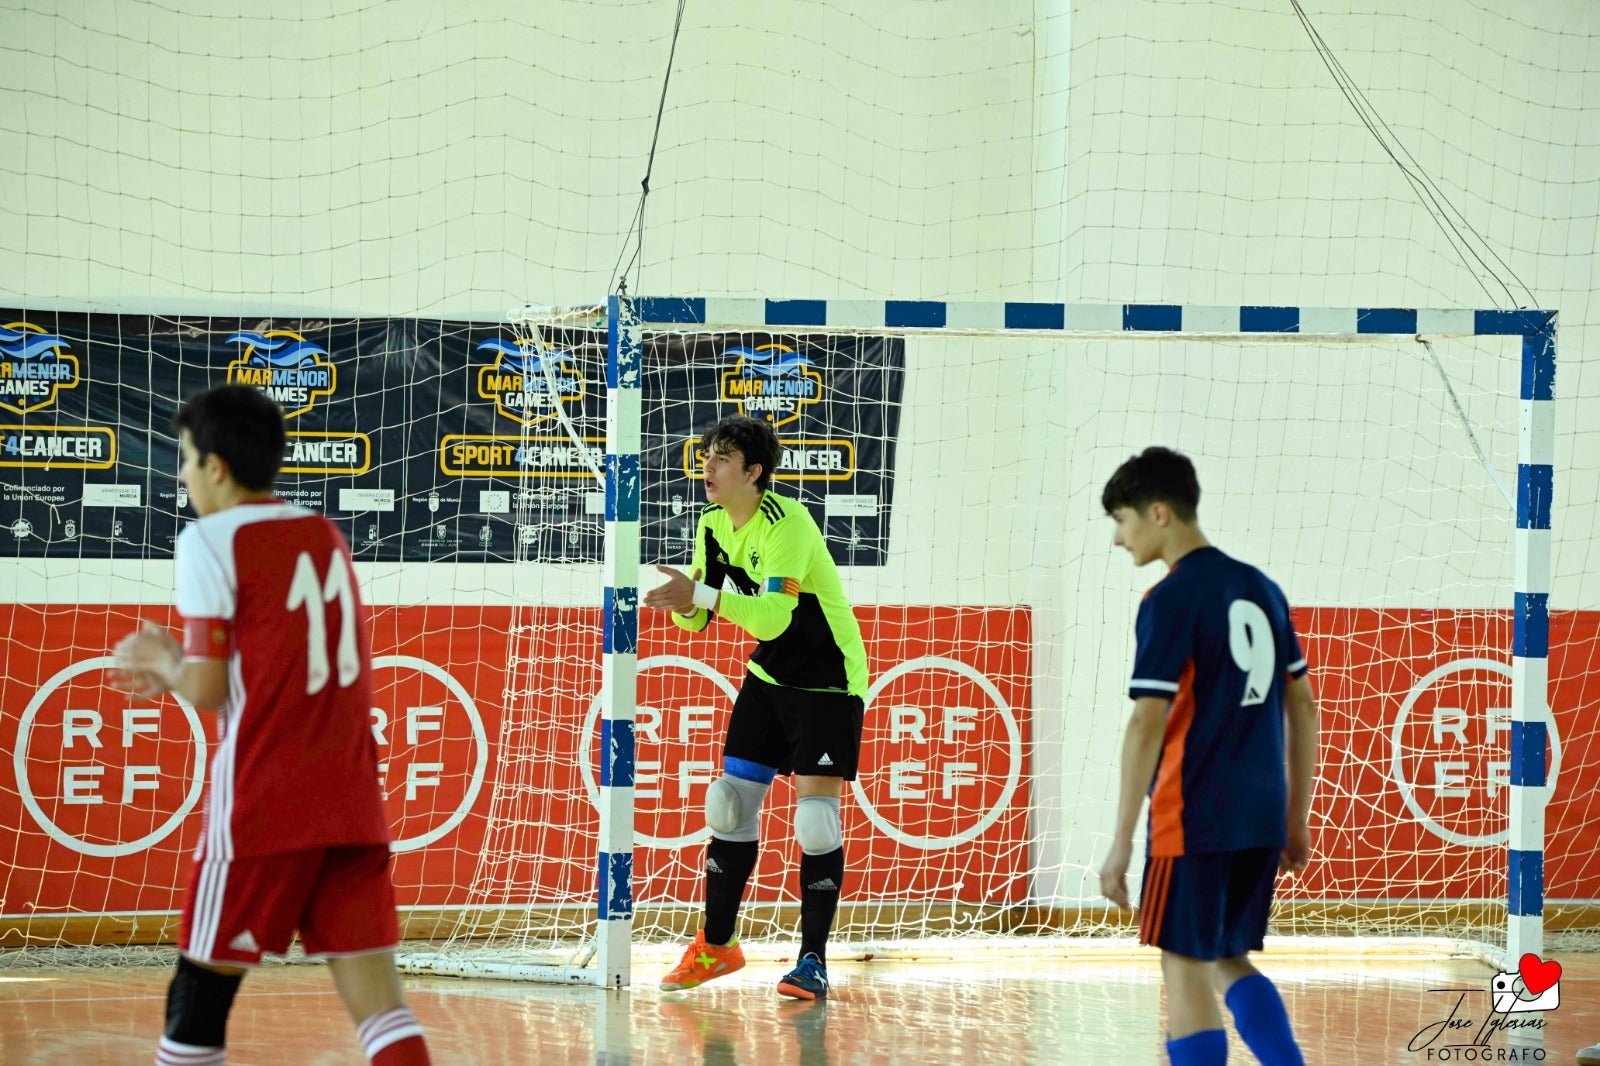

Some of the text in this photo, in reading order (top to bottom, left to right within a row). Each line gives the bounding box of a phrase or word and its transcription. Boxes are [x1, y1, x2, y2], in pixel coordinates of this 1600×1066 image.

[0, 362, 71, 380] RMENOR
[237, 369, 328, 387] MARMENOR
[487, 375, 577, 392] MARMEOR
[729, 379, 814, 396] MARMENOR
[256, 387, 308, 402] AMES
[746, 396, 795, 411] GAMES
[3, 484, 51, 492] Cofinanciado
[35, 494, 65, 502] Europea
[293, 498, 322, 507] Europea
[286, 547, 360, 695] 11
[1228, 598, 1276, 707] 9
